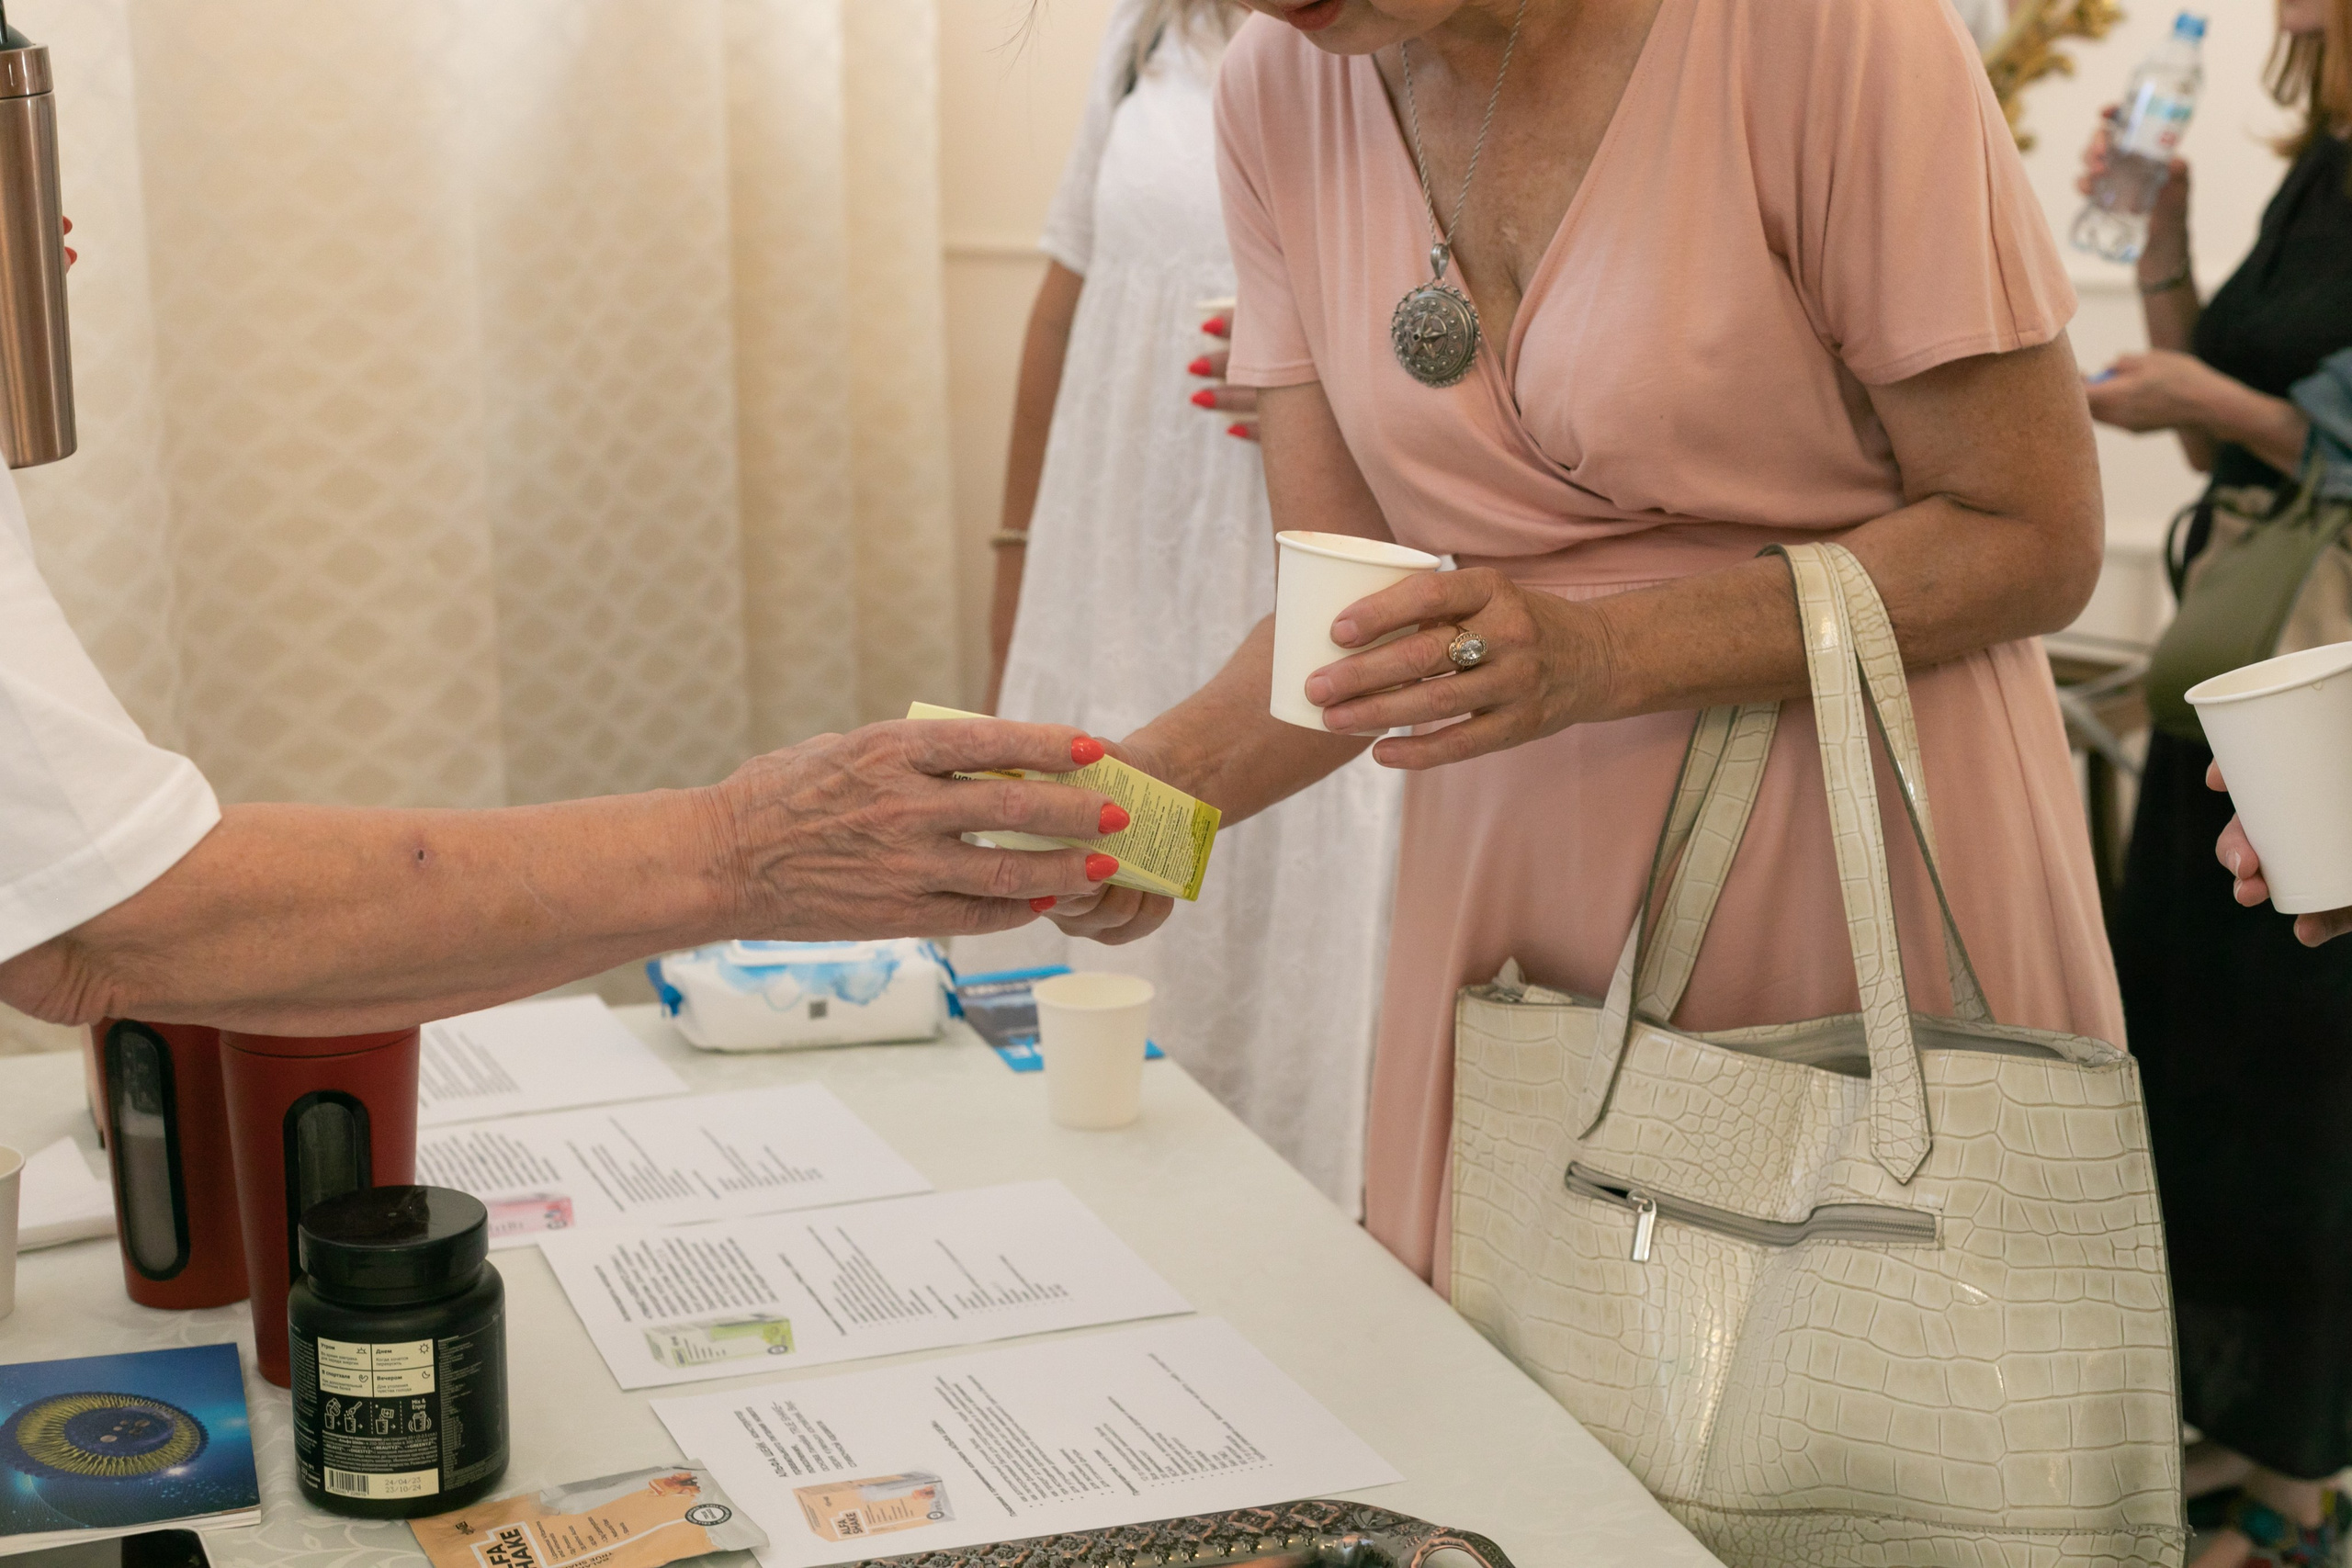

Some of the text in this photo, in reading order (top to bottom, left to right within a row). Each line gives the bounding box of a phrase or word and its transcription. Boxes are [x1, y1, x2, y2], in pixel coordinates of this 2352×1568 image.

[325, 1371, 351, 1379] спортзале
[385, 1476, 422, 1485] 24/04/23
[385, 1484, 422, 1494] 23/10/24
[836, 1518, 852, 1536] ALFA
[845, 1512, 864, 1535] SHAKE
[500, 1529, 535, 1568] HAKE
